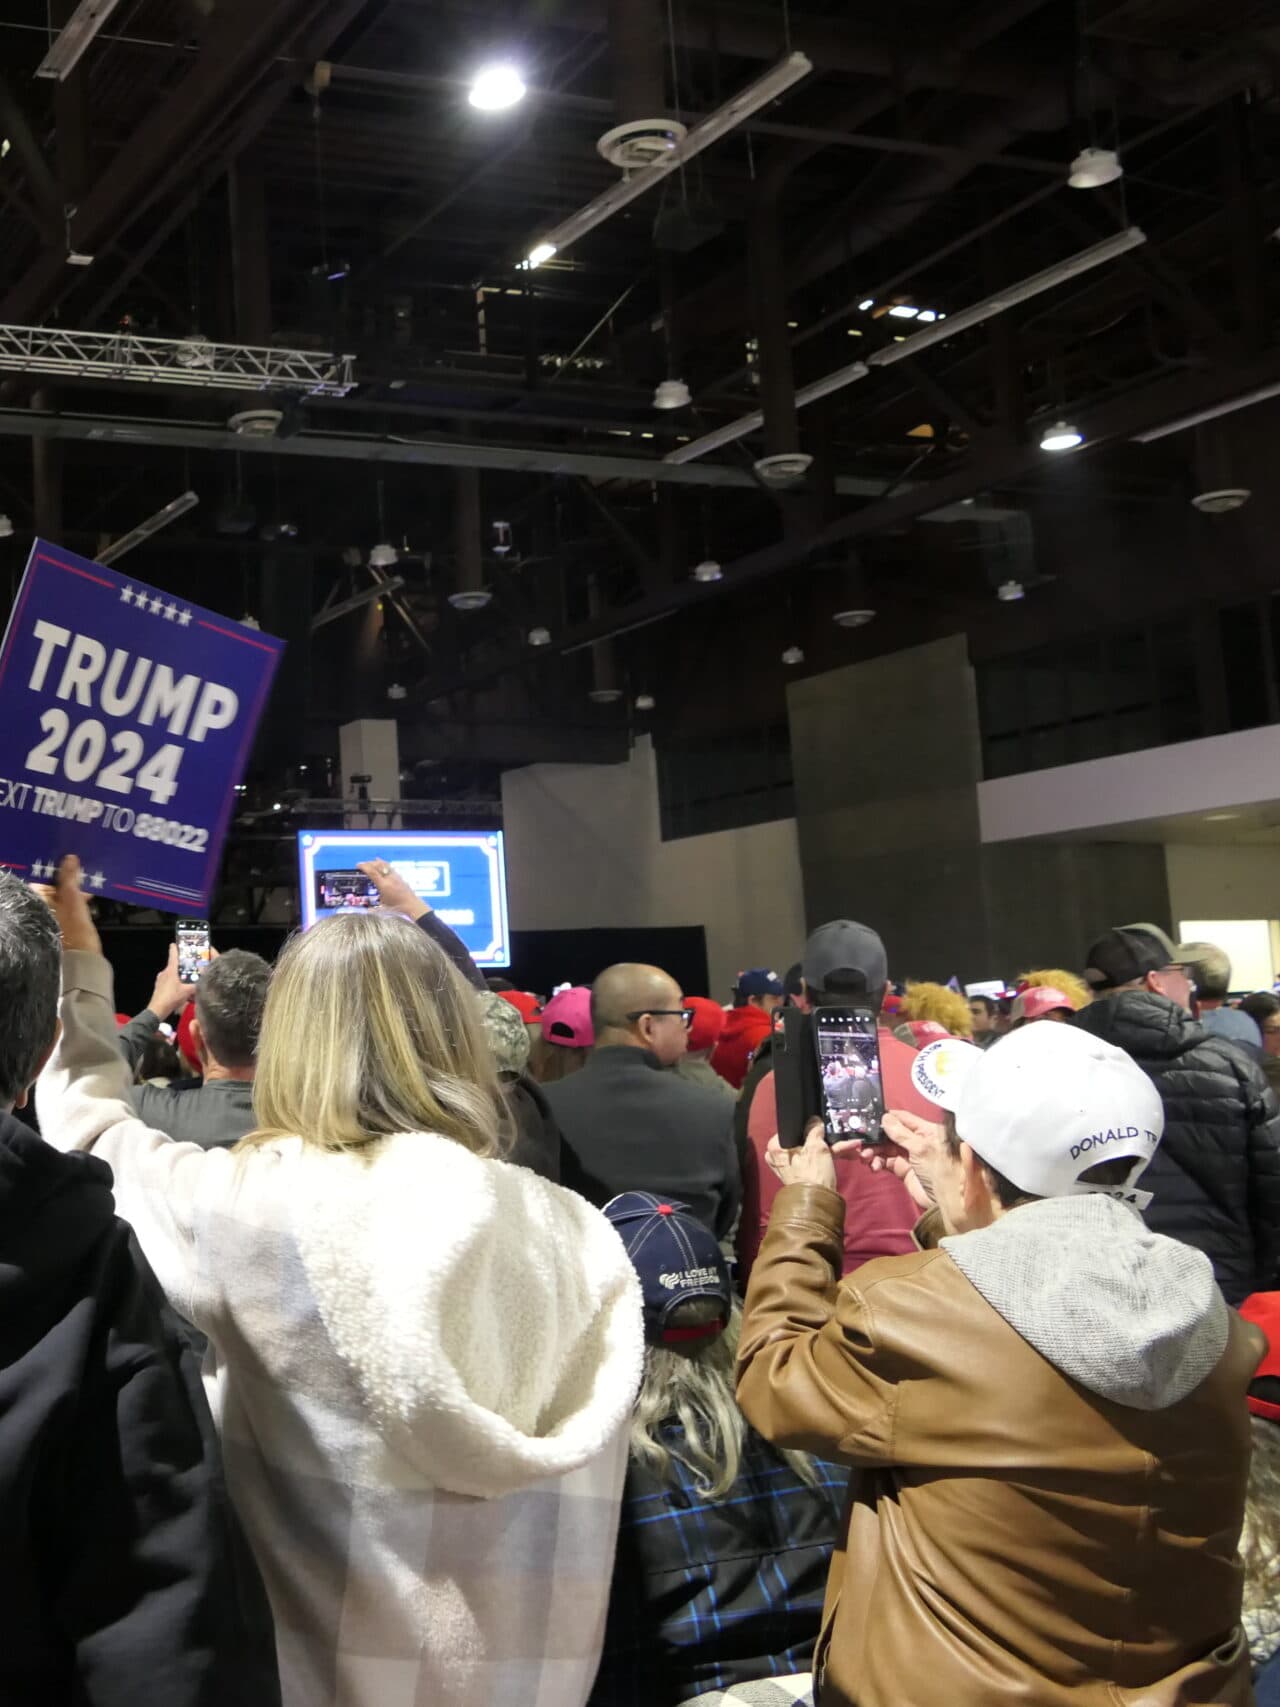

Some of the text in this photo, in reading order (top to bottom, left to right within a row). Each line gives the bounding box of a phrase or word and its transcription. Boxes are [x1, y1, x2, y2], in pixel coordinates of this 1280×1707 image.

[27, 618, 239, 743] TRUMP
[24, 708, 185, 805] 2024
[31, 786, 105, 824] TRUMP
[101, 803, 136, 833] TO
[1070, 1126, 1139, 1160] DONALD
[684, 1267, 708, 1279] LOVE
